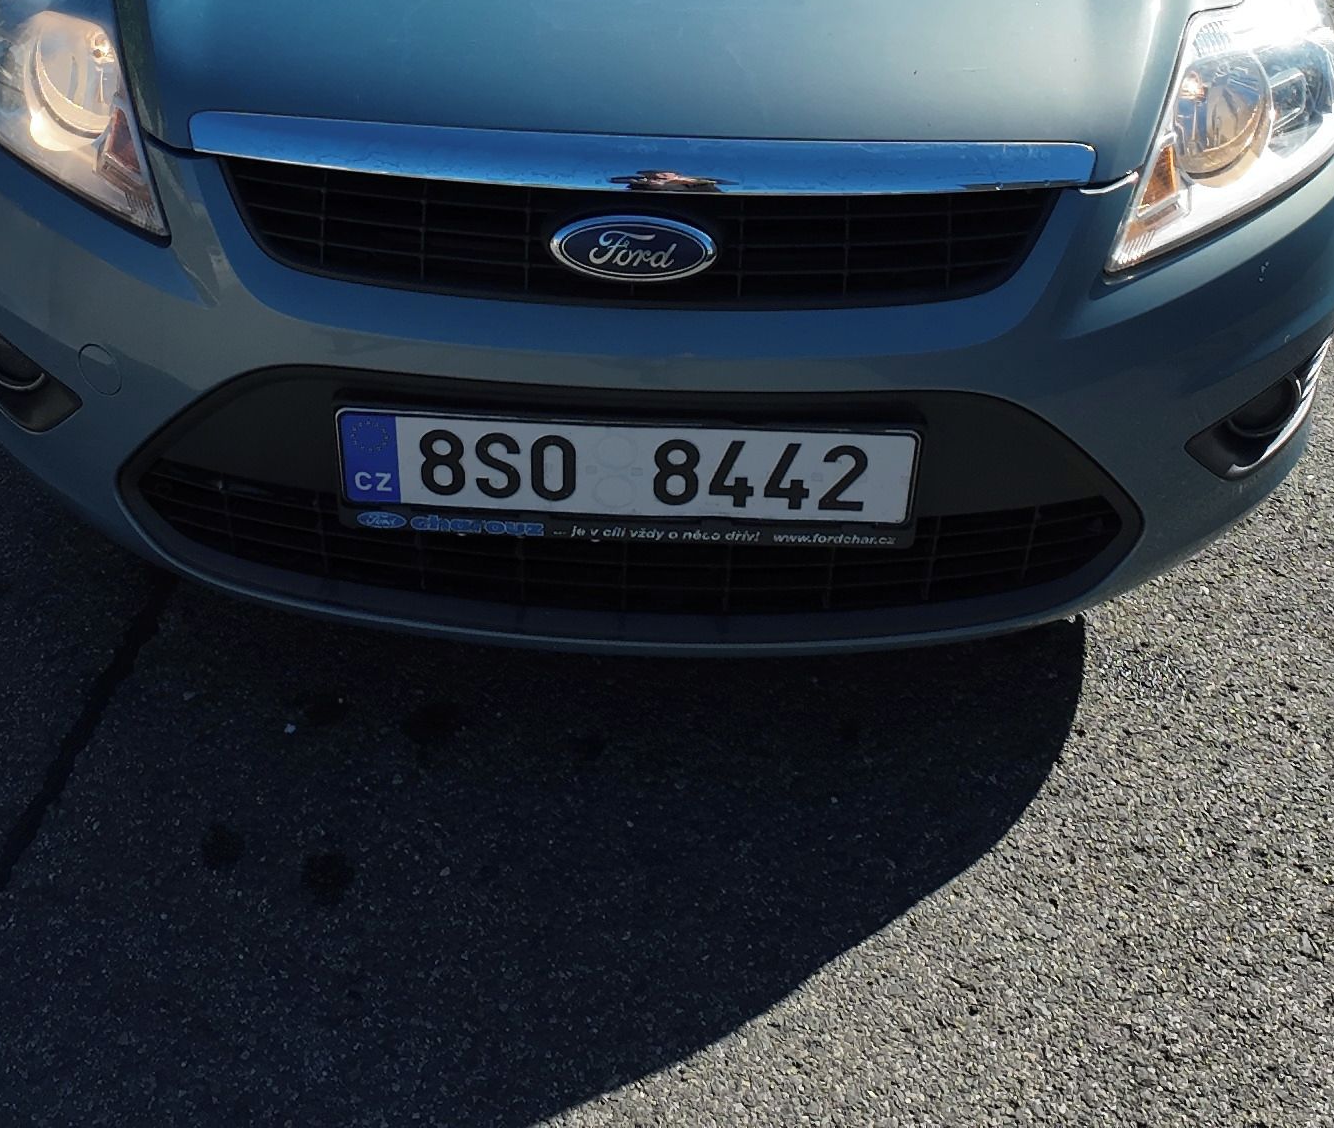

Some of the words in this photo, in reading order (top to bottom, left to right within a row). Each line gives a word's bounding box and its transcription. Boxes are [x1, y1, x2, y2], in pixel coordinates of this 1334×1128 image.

[588, 230, 678, 269] Ford
[354, 471, 393, 492] CZ
[652, 438, 870, 512] 8442
[570, 525, 586, 537] je
[590, 528, 599, 537] v
[629, 527, 665, 541] vždy
[668, 530, 679, 539] o
